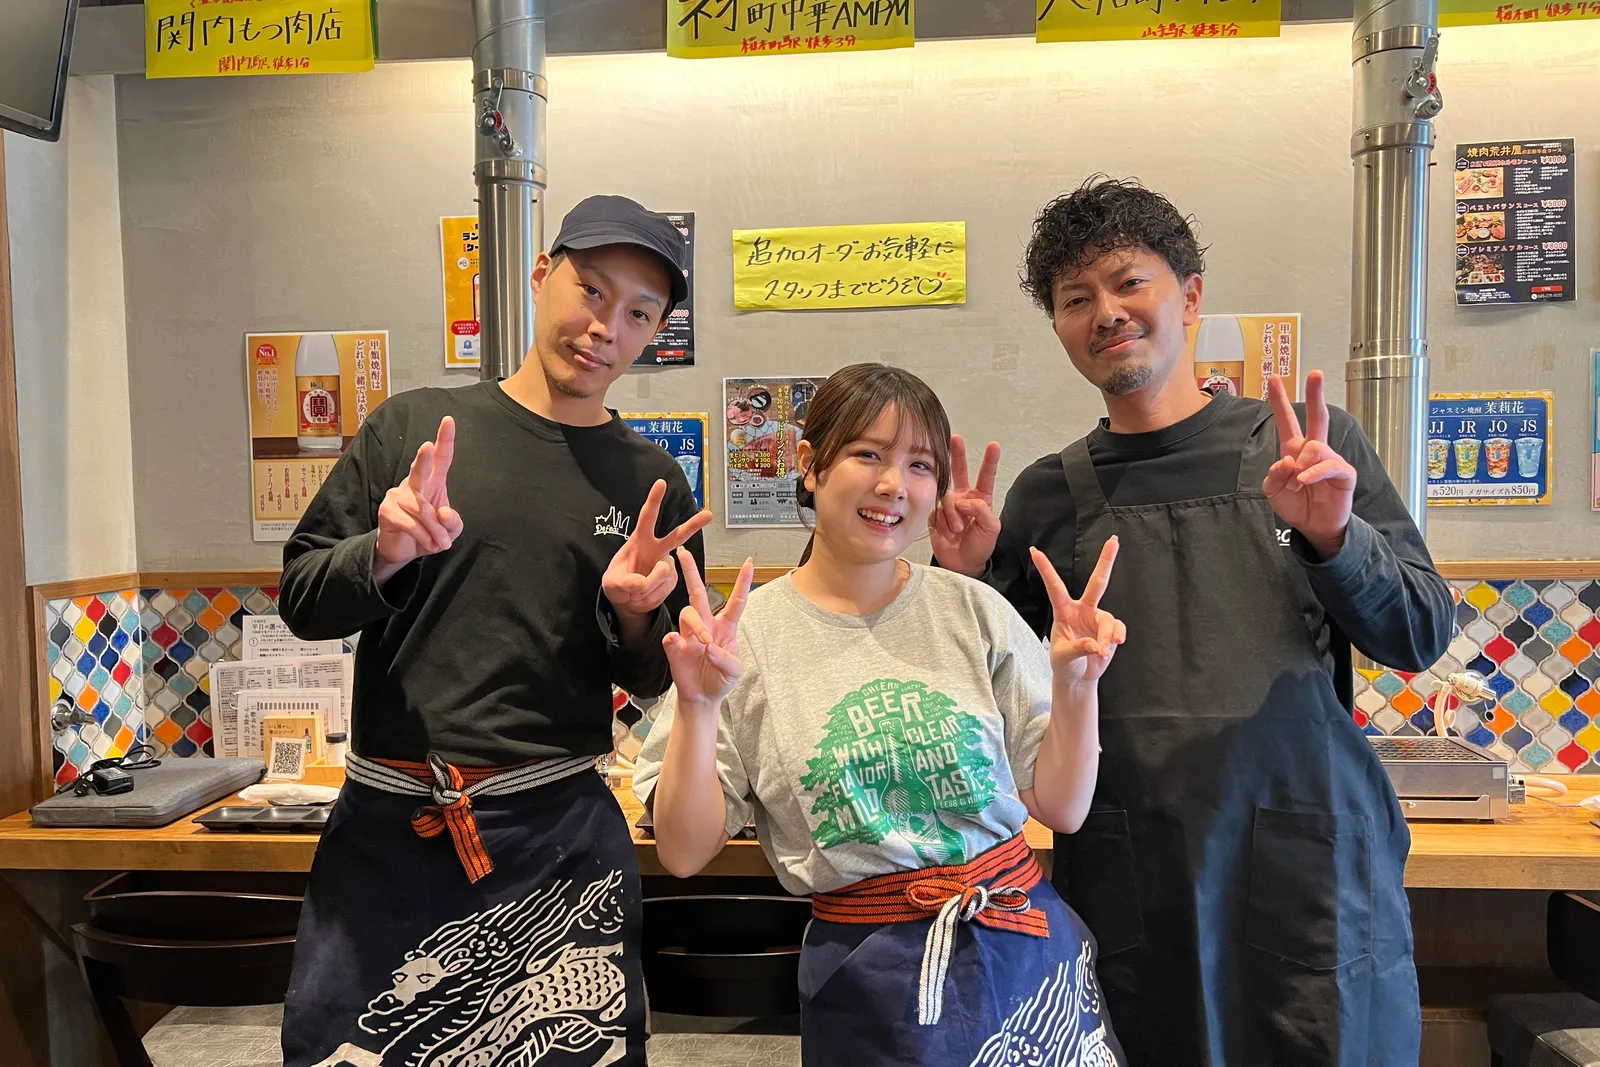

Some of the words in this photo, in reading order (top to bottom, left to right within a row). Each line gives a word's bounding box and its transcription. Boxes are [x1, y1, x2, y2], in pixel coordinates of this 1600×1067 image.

[157, 7, 344, 53] 関内もつ肉店
[746, 234, 954, 266] 追加オーダーお気軽に
[259, 349, 275, 357] No.1
[371, 340, 382, 389] 甲類焼酎は
[1279, 323, 1290, 377] 甲類焼酎は
[1432, 406, 1482, 415] ジャスミン焼酎
[1484, 400, 1524, 414] 茉莉花
[649, 421, 683, 433] 茉莉花
[1458, 420, 1476, 433] JR
[1488, 419, 1507, 432] JO
[1520, 419, 1537, 432] JS
[679, 438, 695, 450] JS
[1432, 486, 1464, 496] 各520円
[861, 681, 899, 697] CHEERS
[846, 690, 924, 738] BEER
[905, 714, 962, 746] CLEAR
[915, 742, 958, 772] AND
[831, 761, 887, 802] FLAVOR
[834, 788, 880, 832] MILD
[940, 799, 958, 809] LESS
[960, 797, 968, 805] IS
